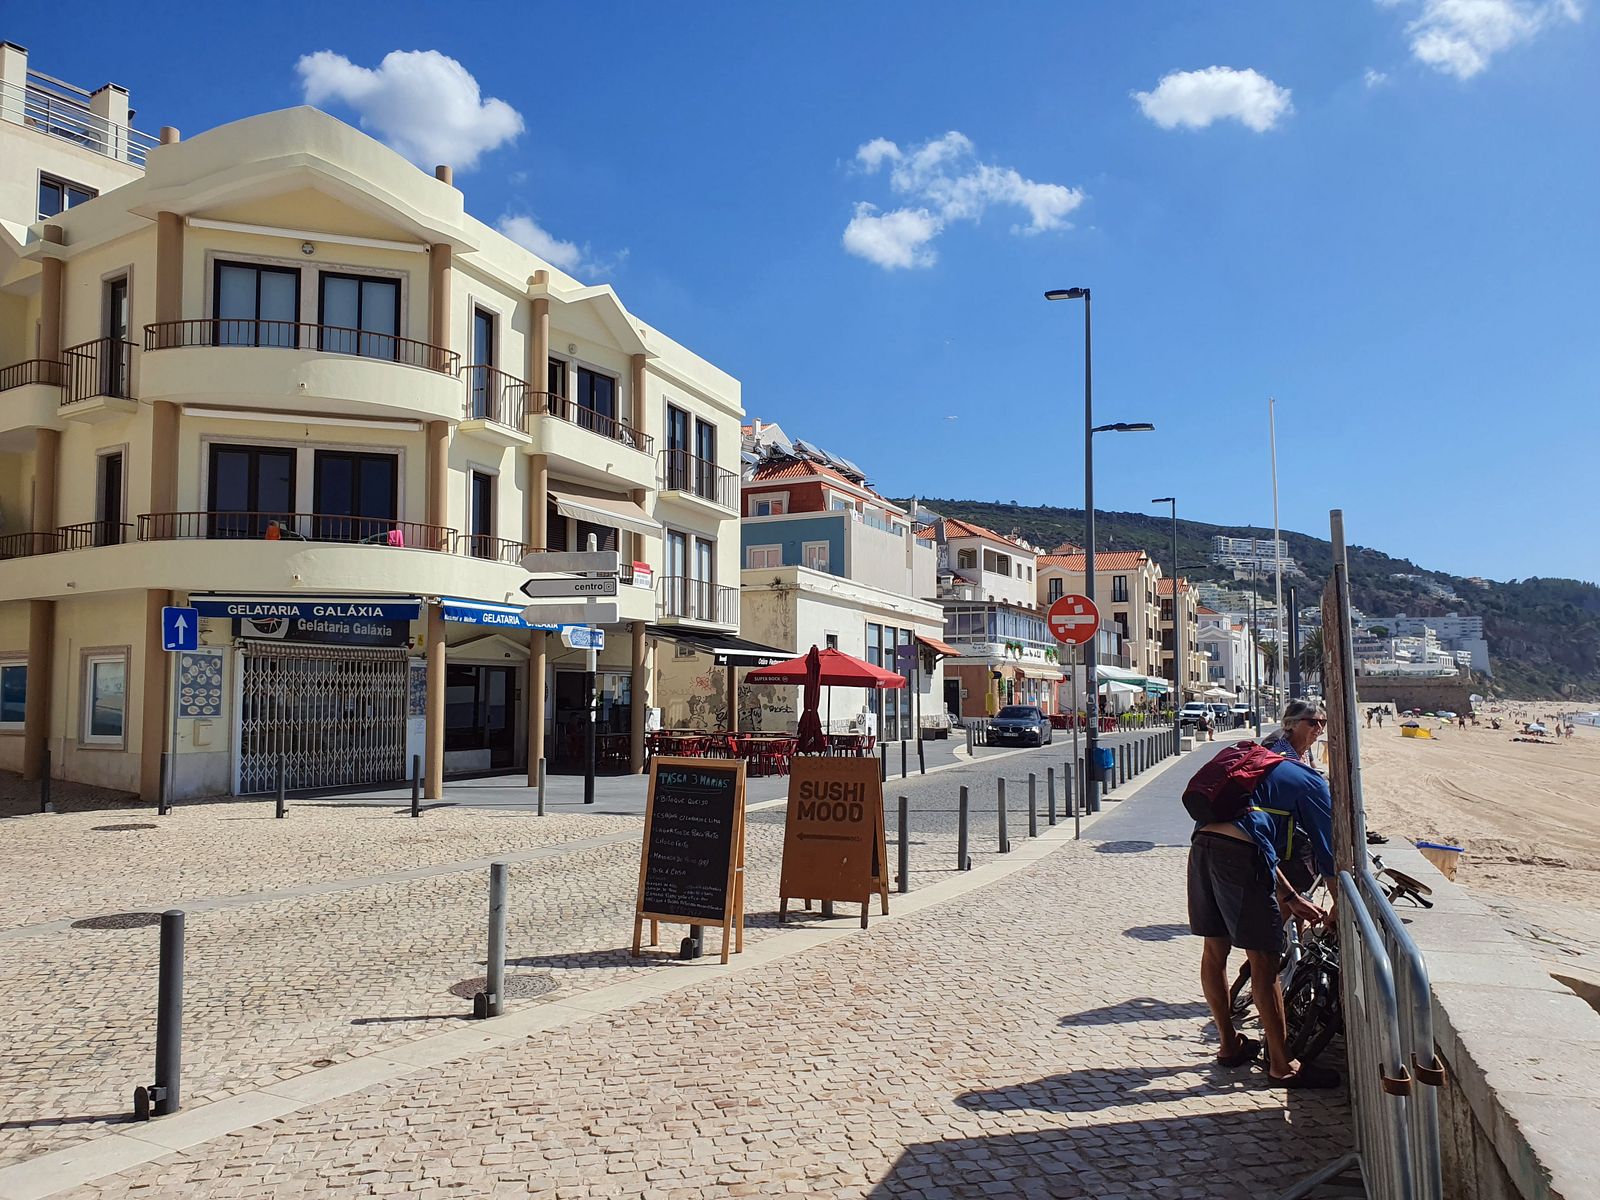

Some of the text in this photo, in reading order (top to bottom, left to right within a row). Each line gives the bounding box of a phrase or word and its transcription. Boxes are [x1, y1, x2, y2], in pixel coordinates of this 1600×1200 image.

[574, 583, 603, 591] centro
[227, 604, 384, 617] GELATARIA GALÁXIA
[482, 613, 520, 625] GELATARIA
[297, 618, 392, 637] Gelataria Galáxia
[658, 772, 730, 788] TASCA 3 MARIAS
[799, 780, 865, 802] SUSHI
[797, 800, 864, 823] MOOD
